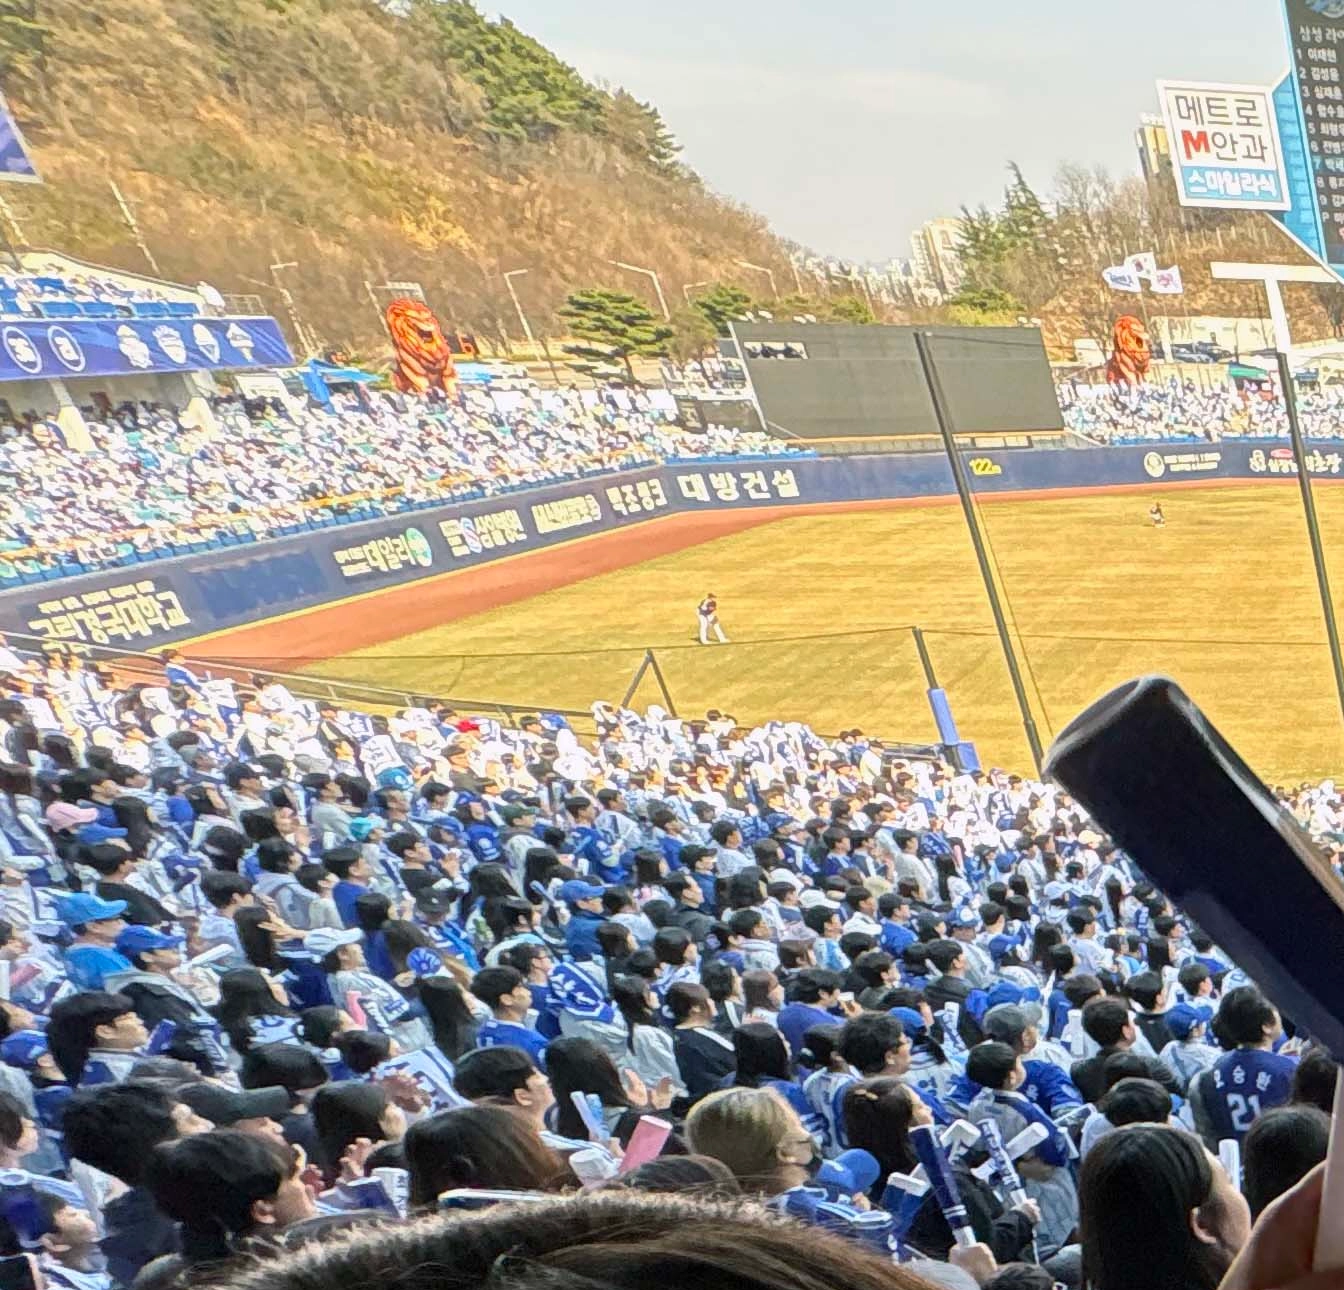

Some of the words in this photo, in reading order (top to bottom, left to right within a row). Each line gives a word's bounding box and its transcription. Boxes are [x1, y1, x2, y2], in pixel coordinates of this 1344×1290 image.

[1175, 95, 1263, 127] 메트로
[1181, 130, 1268, 163] M안과
[1188, 169, 1278, 197] 스마일라식
[676, 469, 800, 502] 대방건설
[1213, 1065, 1273, 1092] 오승환
[1226, 1092, 1264, 1132] 21
